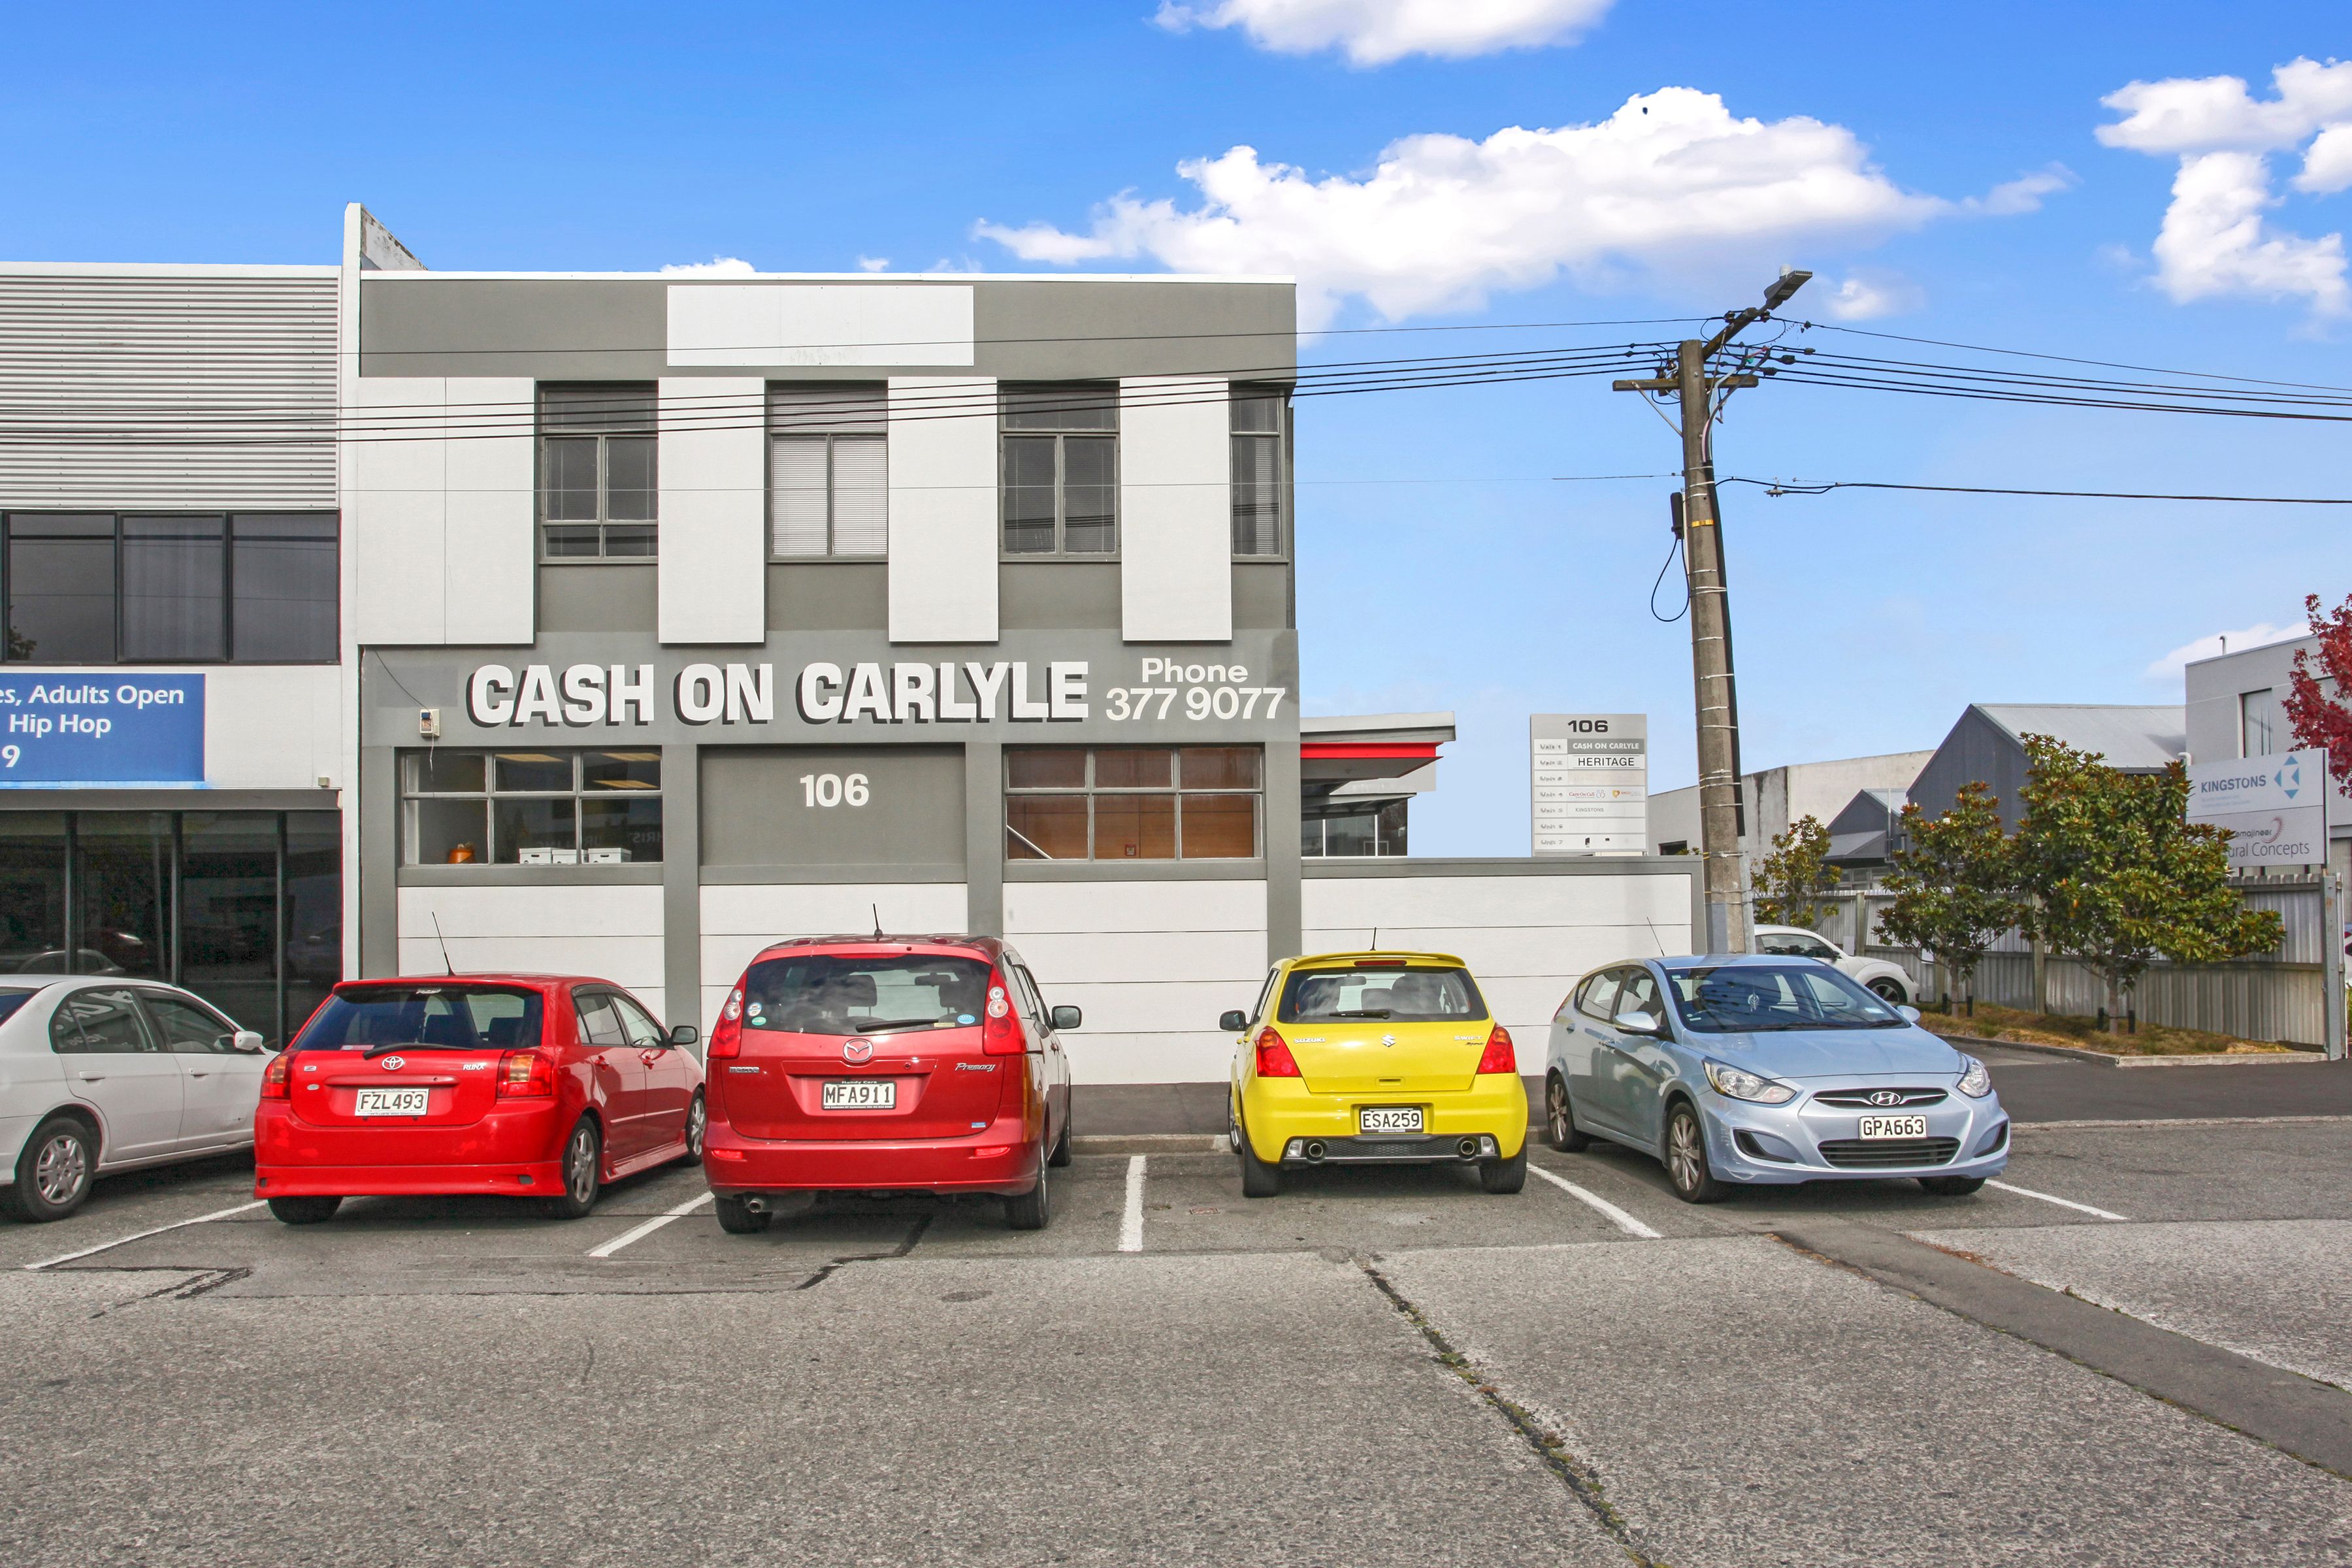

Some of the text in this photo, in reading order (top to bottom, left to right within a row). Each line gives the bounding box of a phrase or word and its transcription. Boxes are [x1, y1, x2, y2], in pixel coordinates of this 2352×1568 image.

[1141, 658, 1248, 683] Phone
[28, 685, 110, 704] Adults
[116, 685, 185, 710] Open
[472, 661, 1089, 723] CASH ON CARLYLE
[1105, 686, 1286, 721] 377 9077
[9, 714, 112, 738] Hip Hop
[1567, 720, 1609, 733] 106
[1578, 757, 1635, 766] HERITAGE
[800, 774, 870, 808] 106
[2200, 775, 2266, 793] KINGSTONS
[2252, 841, 2310, 858] Concepts
[360, 1094, 424, 1109] FZL493
[825, 1086, 890, 1103] MFA911
[1363, 1113, 1420, 1128] ESA259
[1863, 1119, 1924, 1135] GPA663
